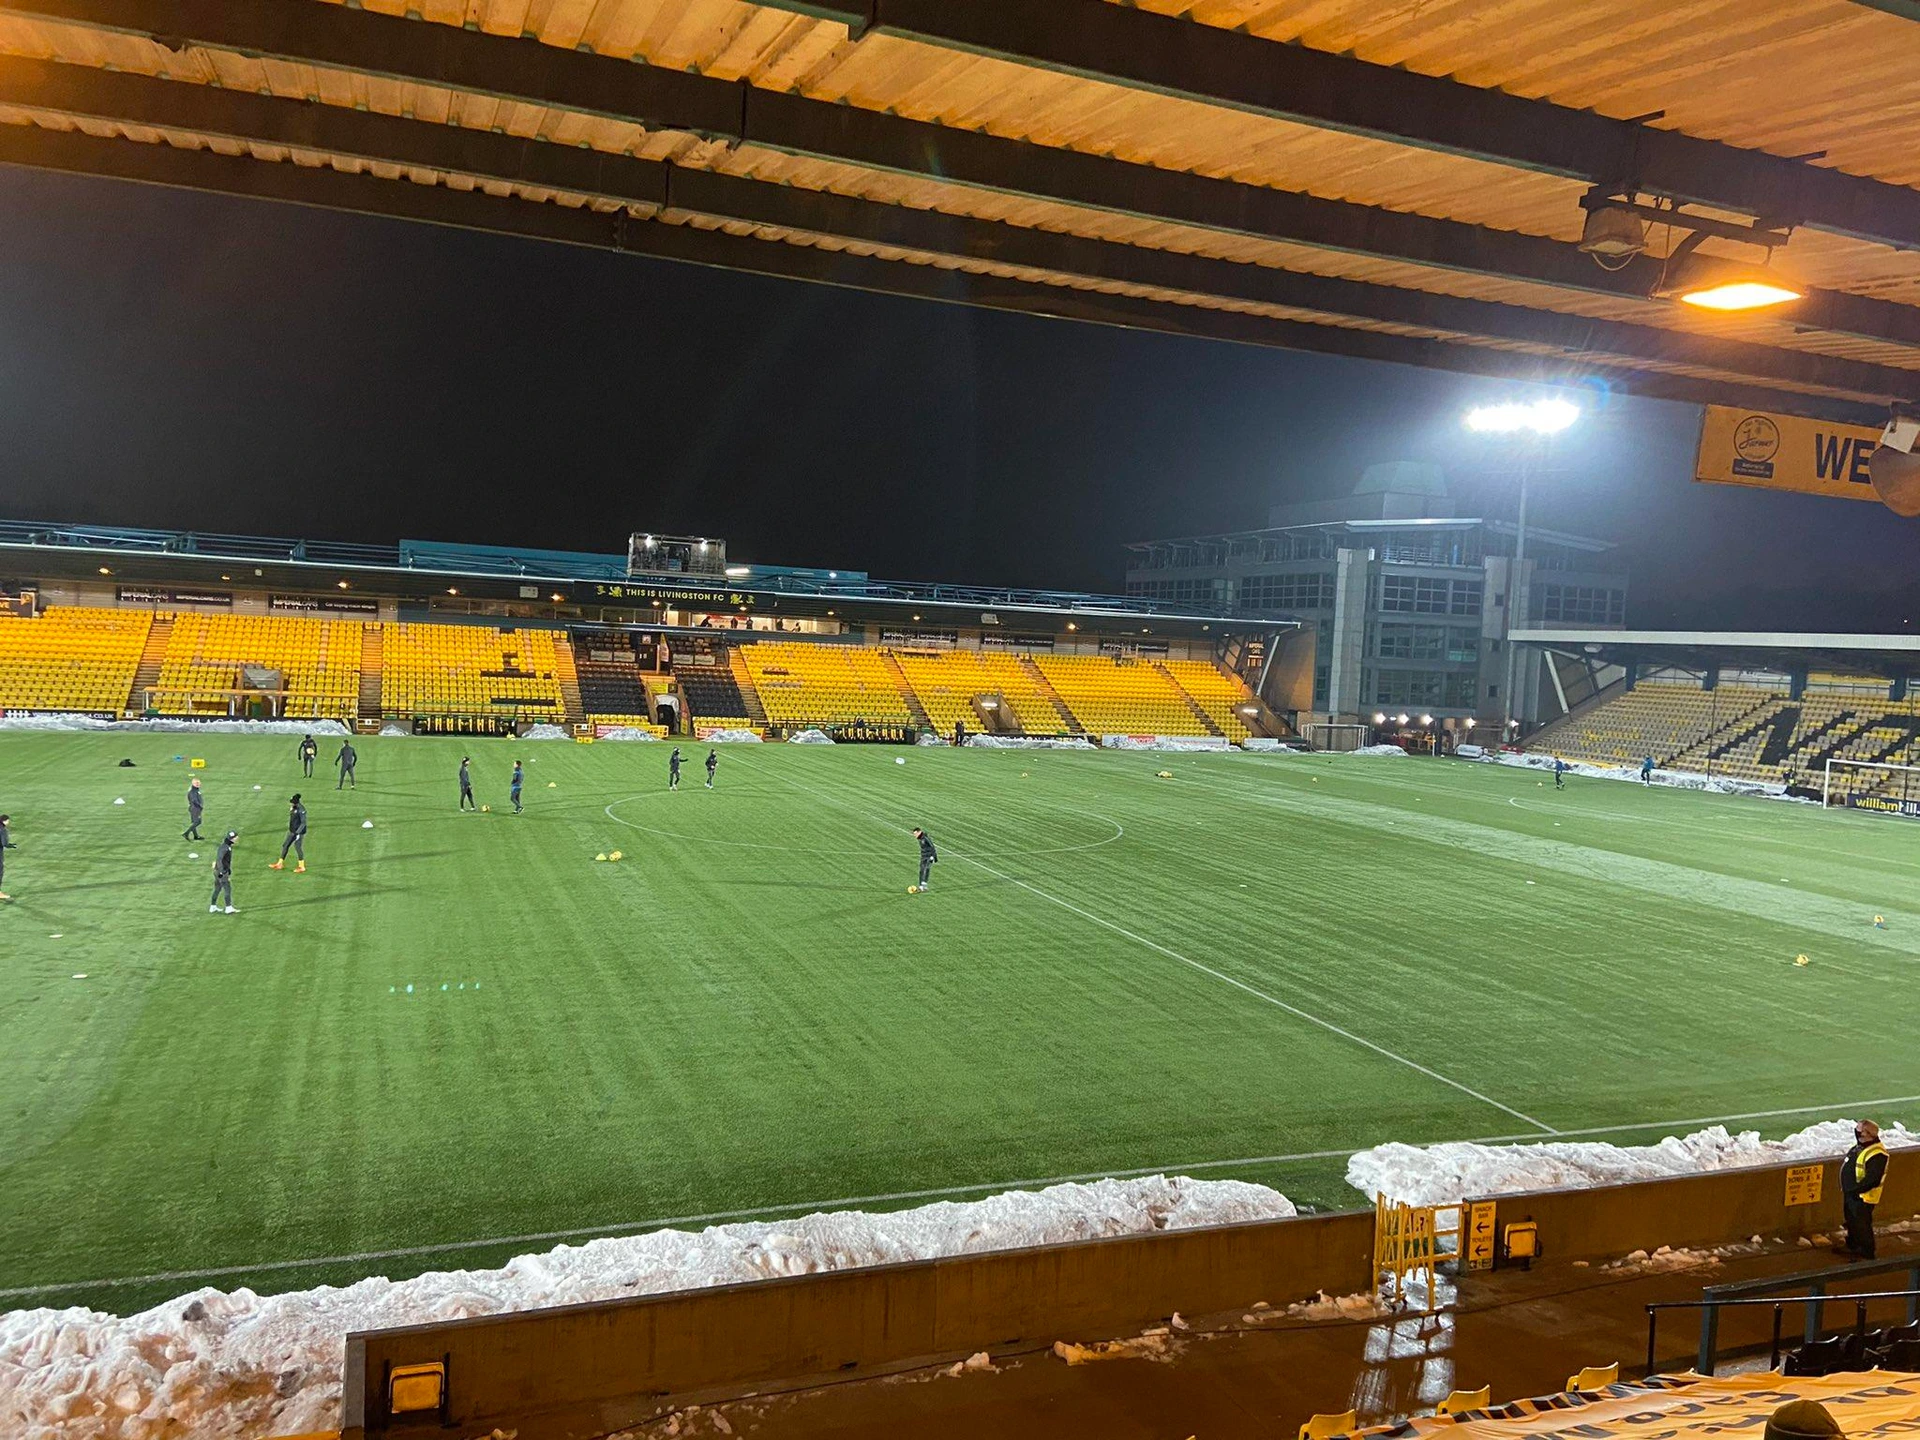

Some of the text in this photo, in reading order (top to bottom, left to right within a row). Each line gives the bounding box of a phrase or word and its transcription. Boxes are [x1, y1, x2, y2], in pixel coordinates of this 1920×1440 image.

[626, 588, 725, 602] THIS IS LIVINGSTON FC
